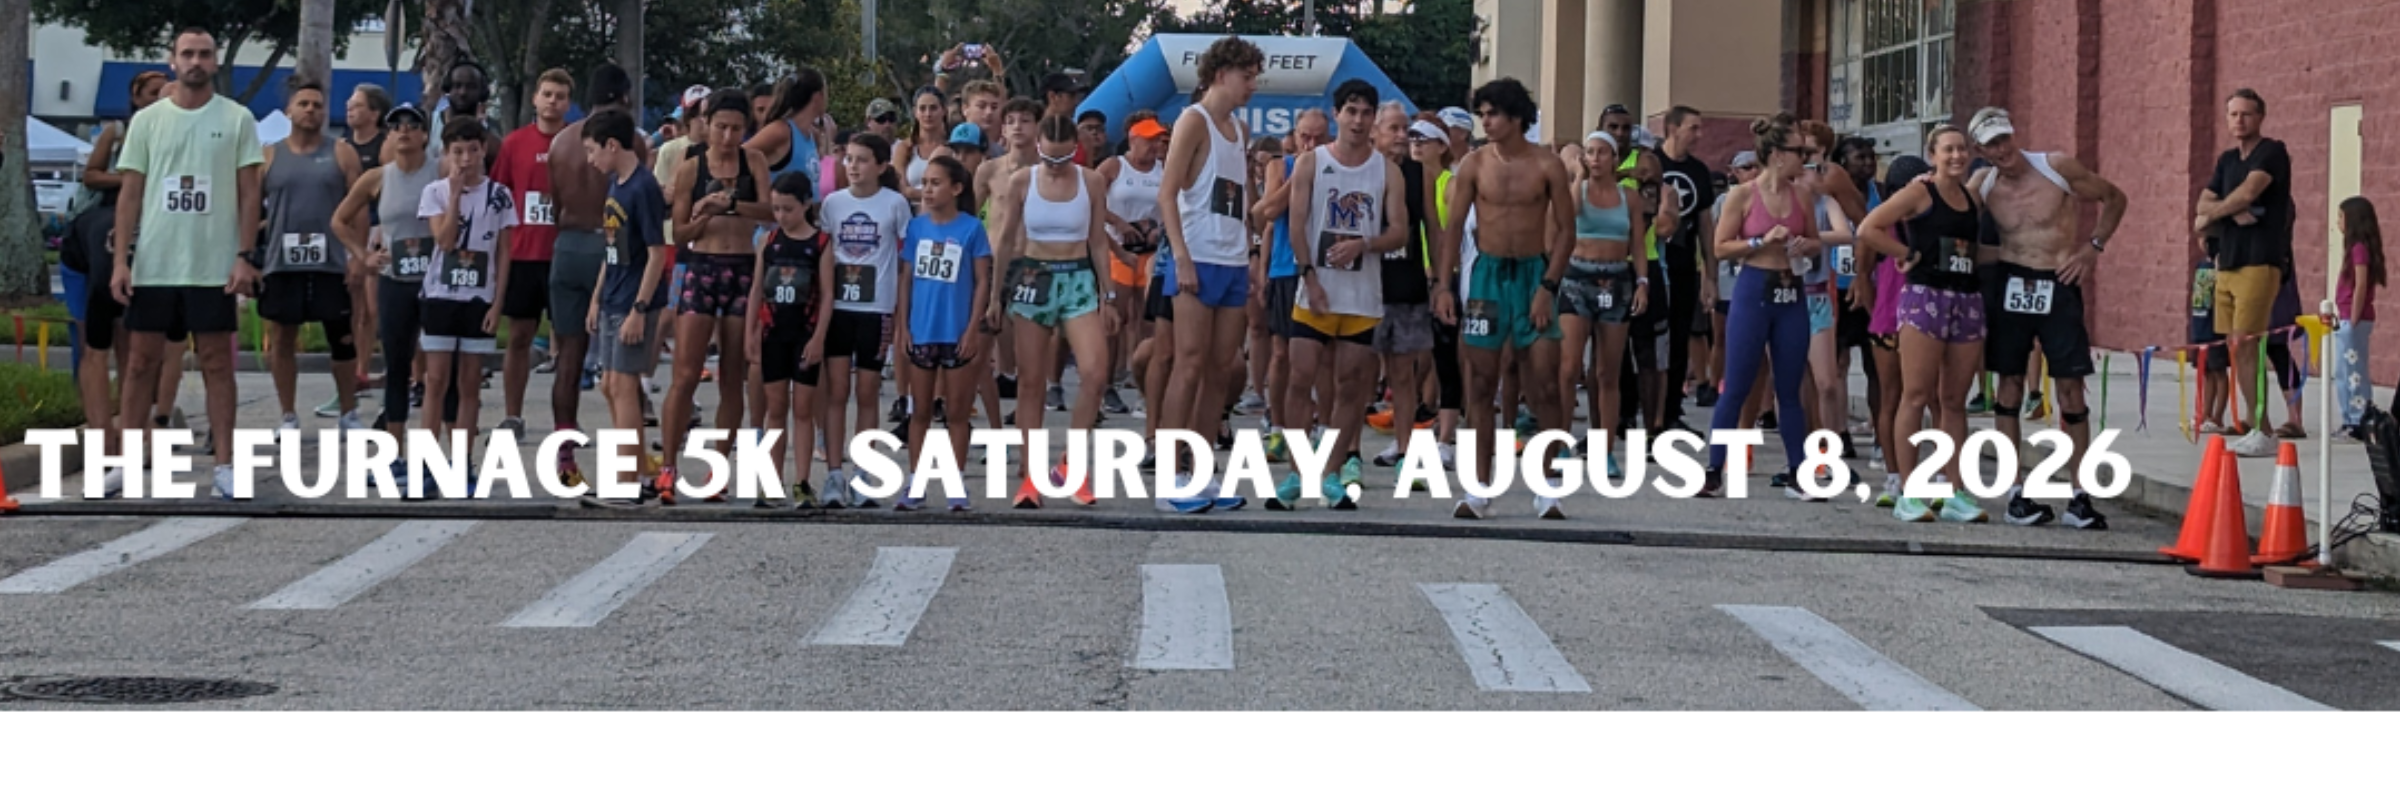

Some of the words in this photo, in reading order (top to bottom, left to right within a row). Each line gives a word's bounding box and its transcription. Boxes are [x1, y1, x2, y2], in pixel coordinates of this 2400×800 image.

[1268, 55, 1317, 70] FEET
[167, 190, 206, 212] 560
[1226, 201, 1234, 217] 1
[290, 245, 321, 264] 576
[917, 254, 953, 278] 503
[450, 268, 479, 287] 139
[775, 285, 796, 303] 80
[842, 283, 860, 301] 76
[2010, 292, 2047, 312] 536
